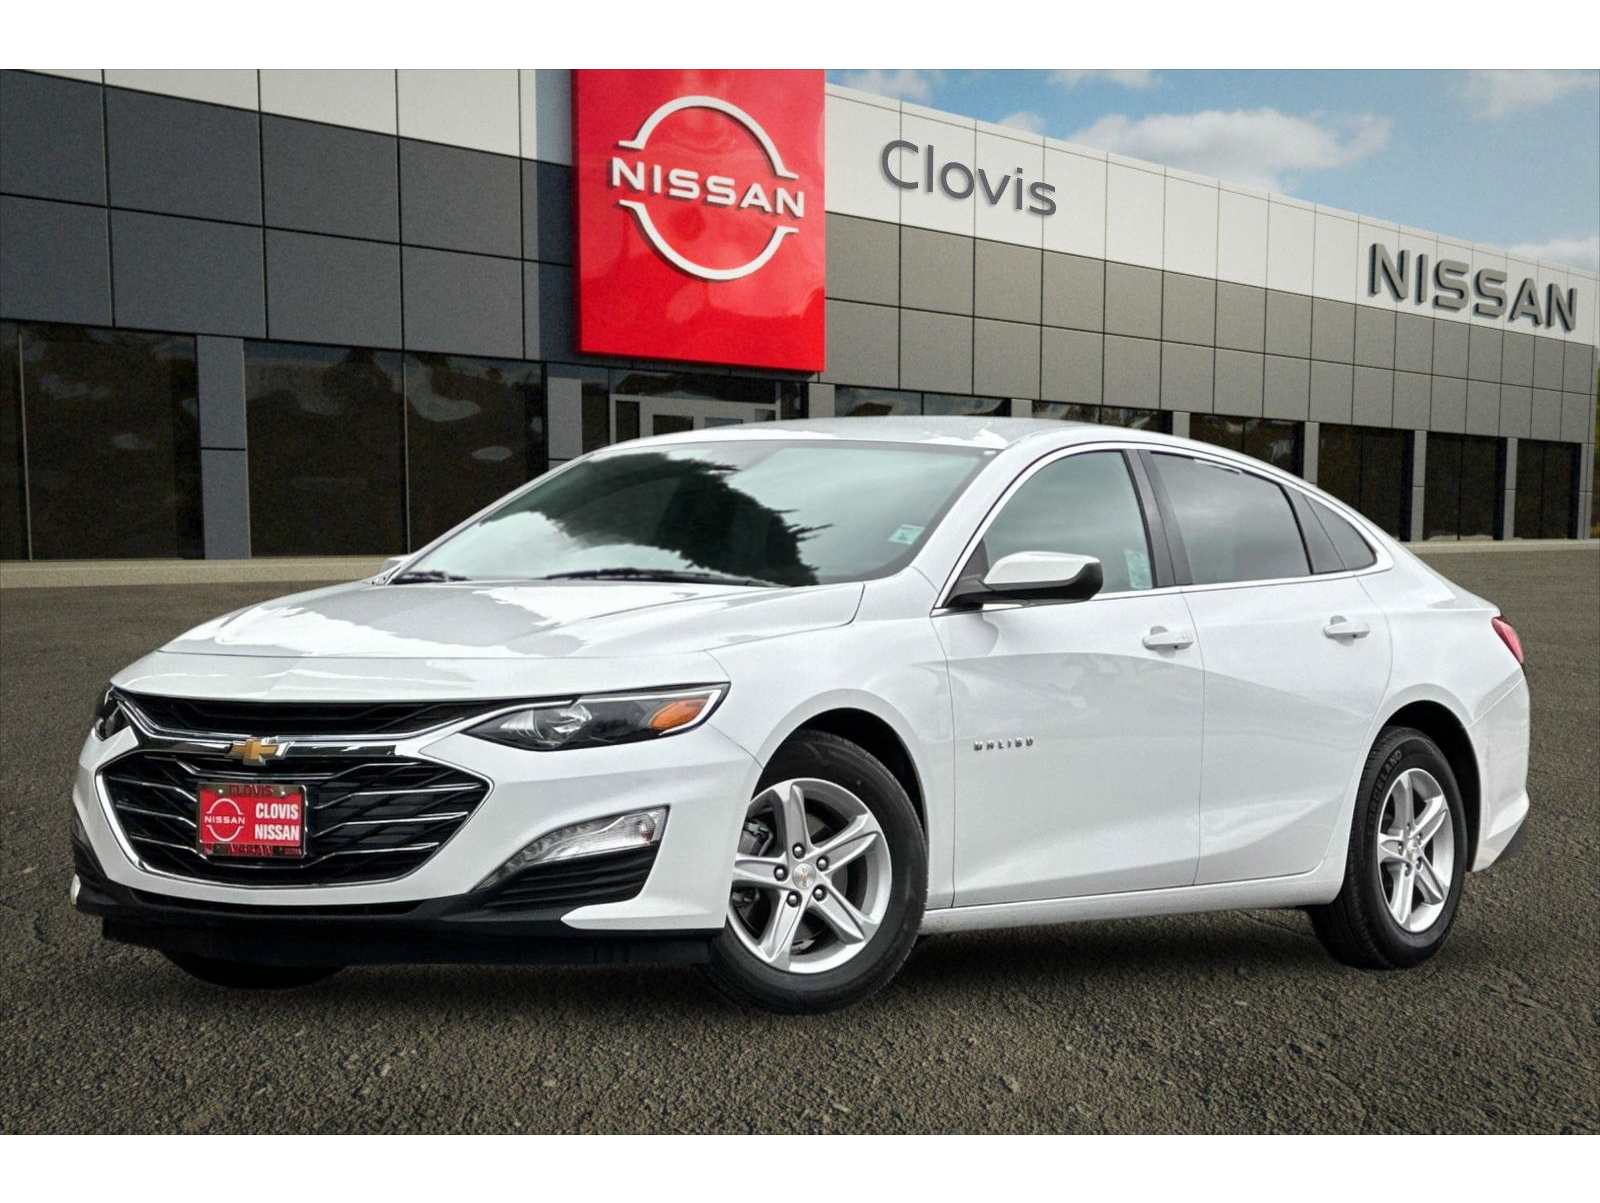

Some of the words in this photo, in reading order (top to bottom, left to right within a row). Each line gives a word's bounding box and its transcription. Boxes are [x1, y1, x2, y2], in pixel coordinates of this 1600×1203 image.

[611, 156, 805, 218] NISSAN
[881, 139, 1057, 216] Clovis
[1368, 242, 1578, 333] NISSAN
[204, 815, 246, 825] NISSAN
[255, 802, 299, 820] CLOVIS
[254, 823, 300, 841] NISSAN
